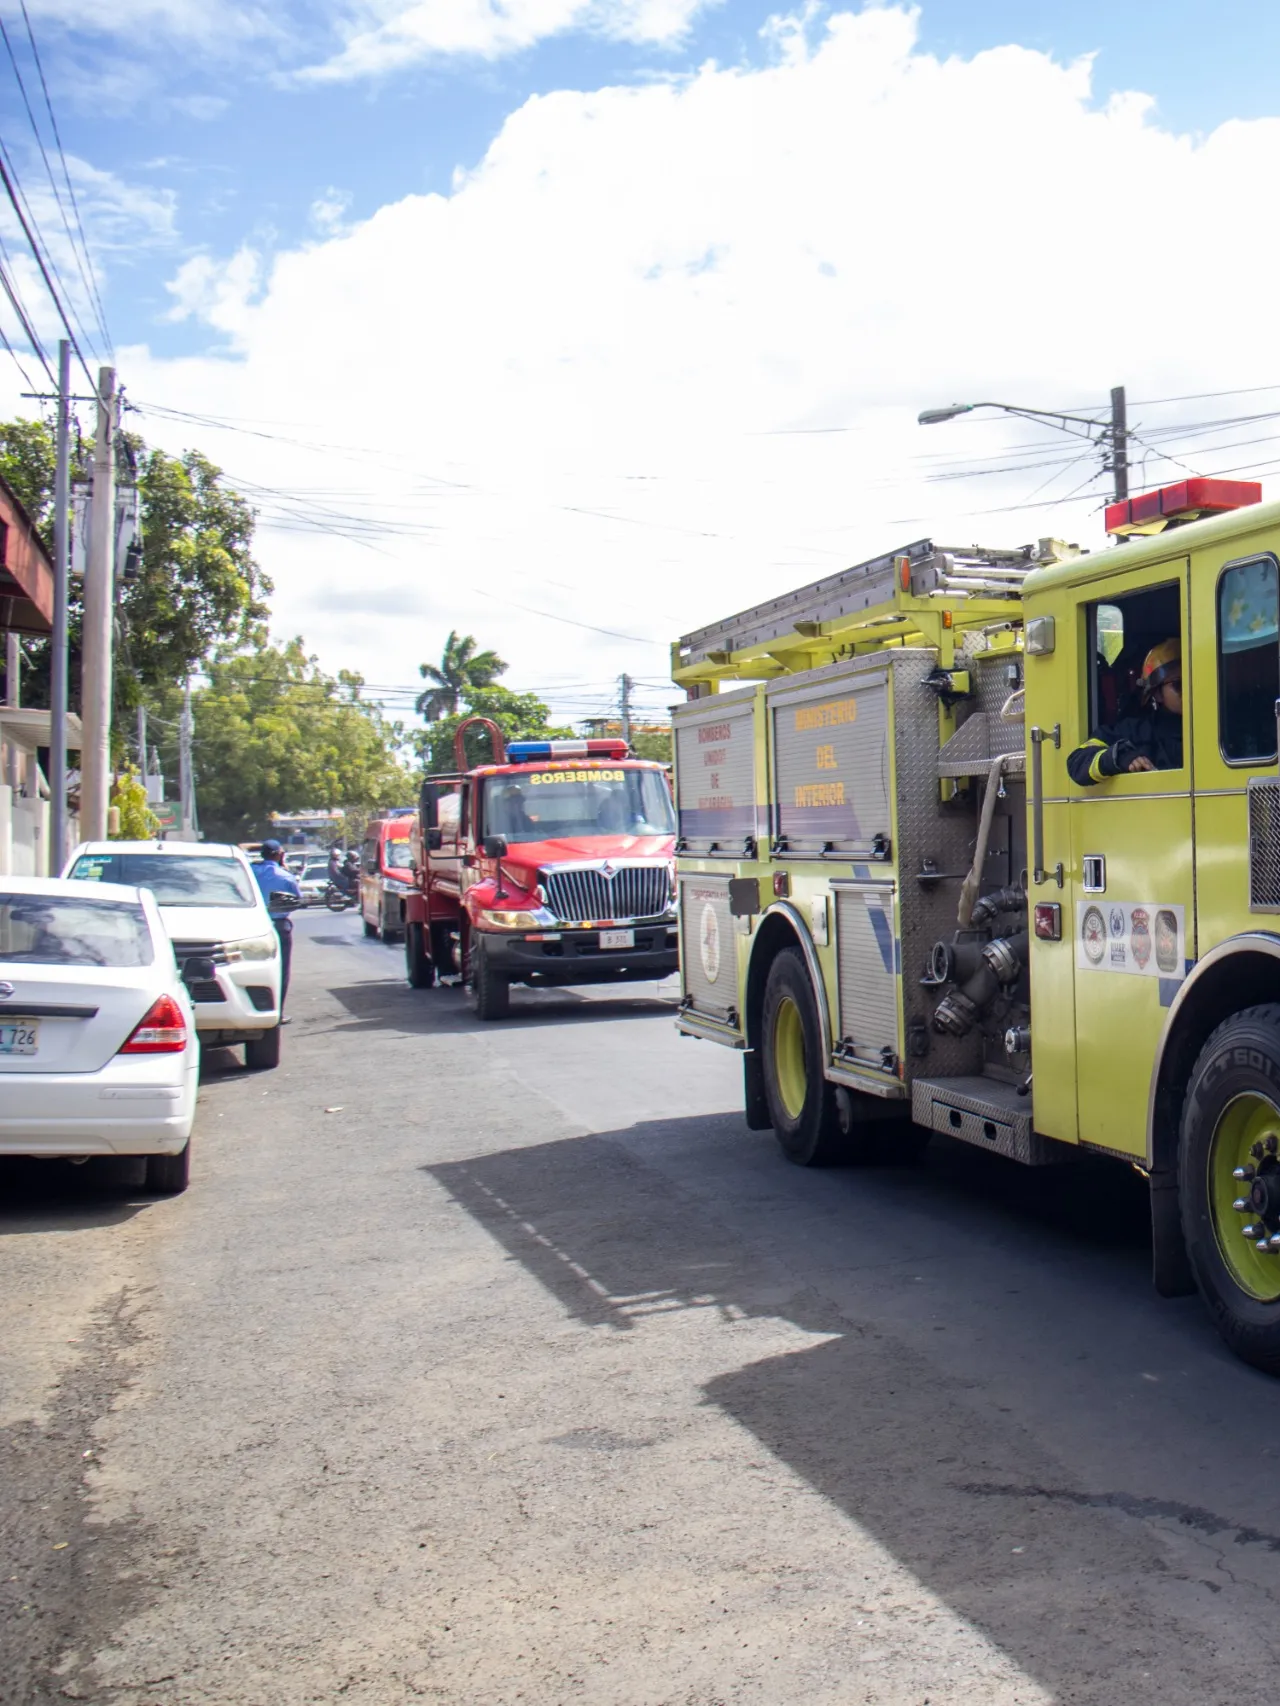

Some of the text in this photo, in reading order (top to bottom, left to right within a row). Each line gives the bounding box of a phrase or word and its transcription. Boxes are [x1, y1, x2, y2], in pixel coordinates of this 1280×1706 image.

[795, 698, 856, 731] MINISTERIO
[816, 744, 838, 769] DEL
[795, 782, 845, 807] INTERIOR
[10, 1029, 36, 1045] 726
